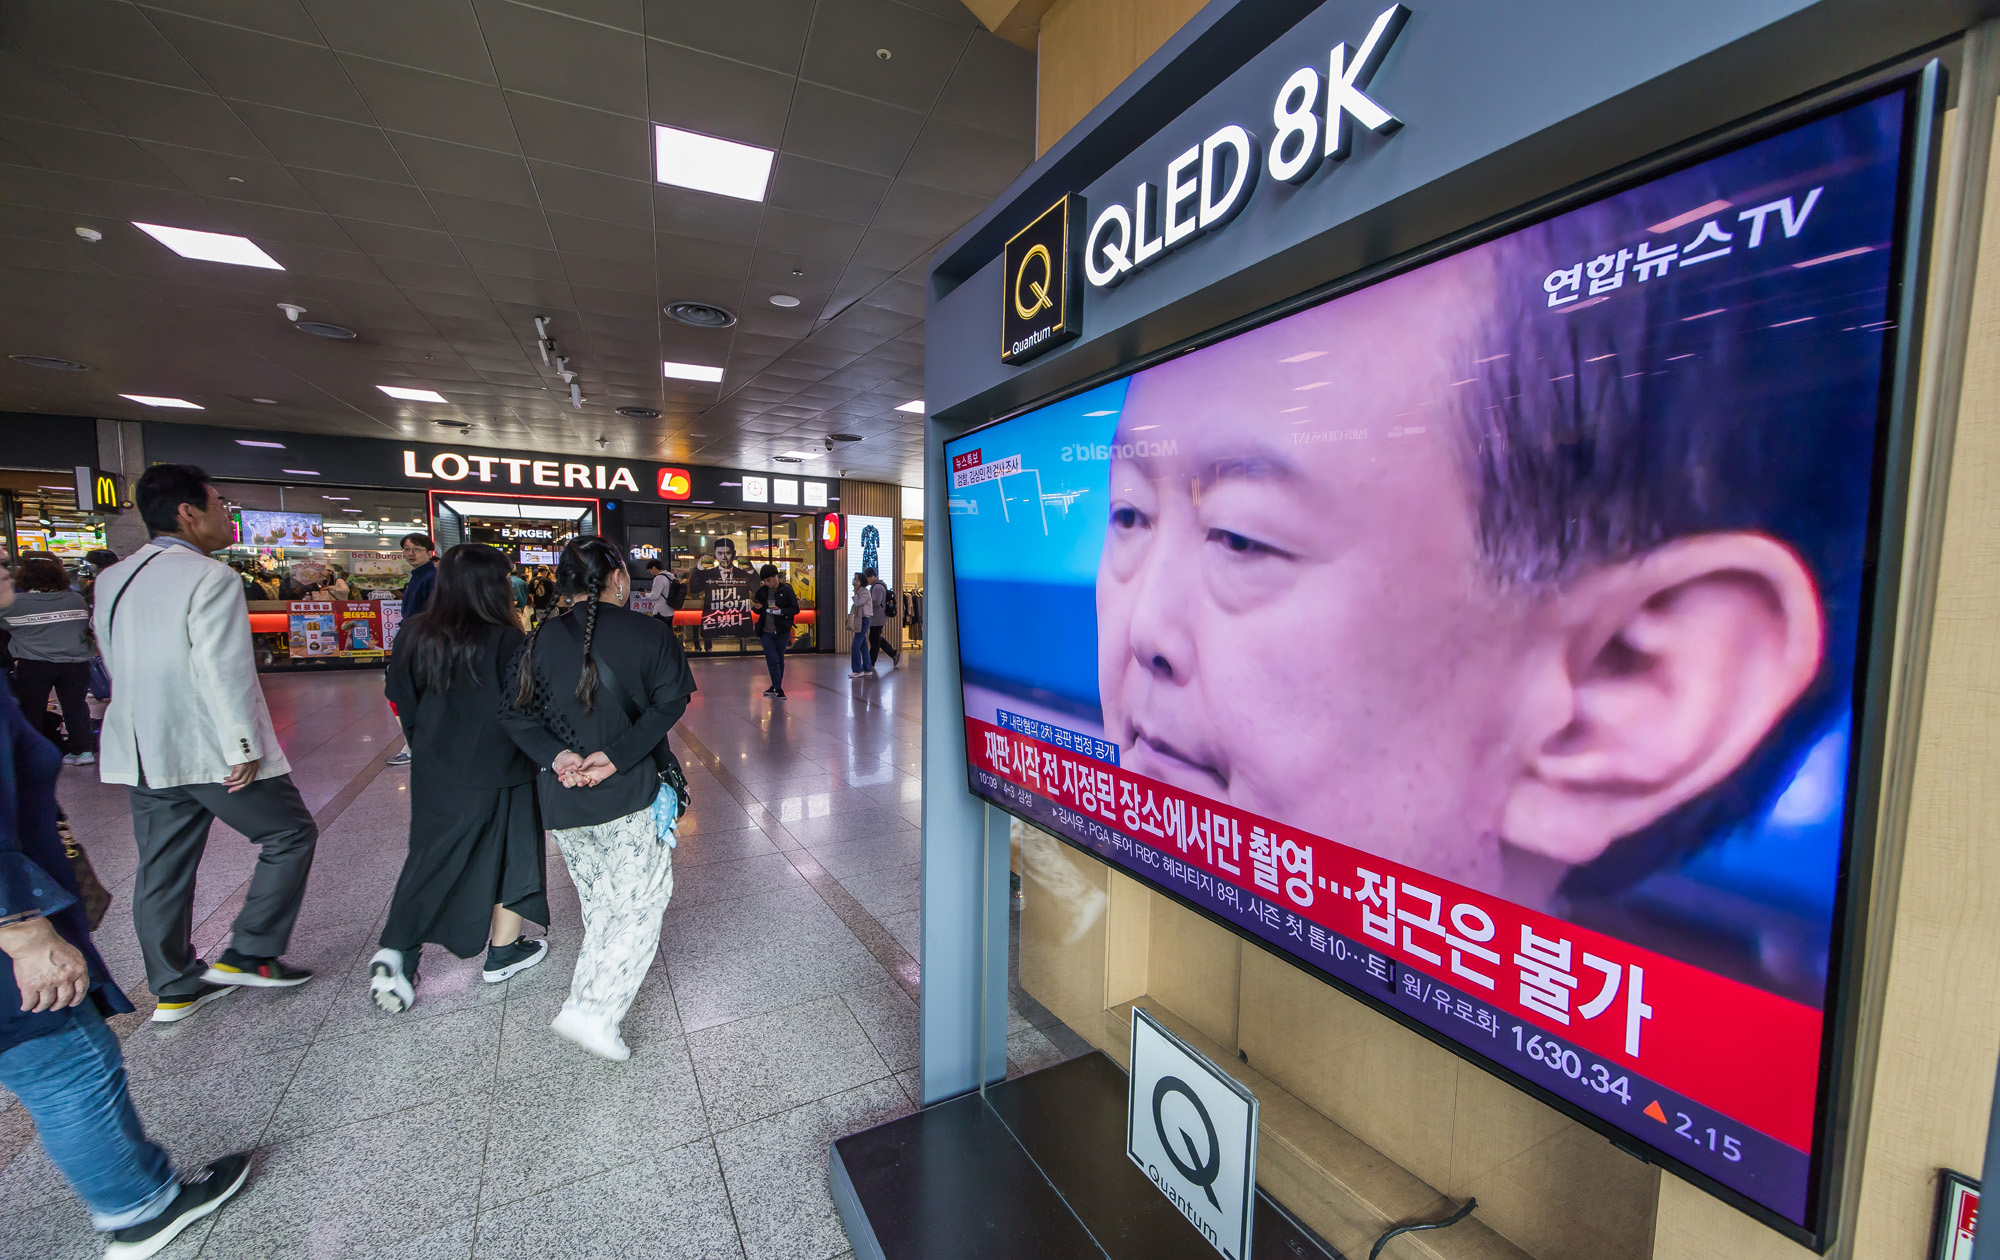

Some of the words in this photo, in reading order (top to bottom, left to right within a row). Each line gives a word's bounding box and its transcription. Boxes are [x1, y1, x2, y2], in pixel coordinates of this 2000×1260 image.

[1085, 124, 1250, 286] QLED
[1268, 3, 1399, 181] 8K
[1012, 325, 1051, 355] Quantum
[403, 451, 639, 492] LOTTERIA
[956, 452, 979, 469] 뉴스특보
[957, 472, 969, 487] 검찰,
[986, 465, 992, 479] 전
[993, 462, 1005, 478] 검사
[1005, 458, 1019, 474] 조사
[634, 548, 658, 559] BUN
[704, 599, 751, 616] 맛있게
[711, 587, 740, 601] 버거,
[343, 611, 376, 619] 롯데잇츠
[1040, 725, 1053, 742] 2차
[1054, 729, 1072, 749] 공판
[1073, 734, 1092, 756] 법정
[1094, 742, 1115, 763] 공개
[979, 772, 997, 790] 10:09
[1003, 783, 1015, 799] 4-3
[1017, 789, 1033, 808] 삼성
[1059, 808, 1088, 836] 김시우,
[1088, 822, 1110, 844] PGA
[1112, 835, 1133, 857] 투어
[1135, 844, 1160, 868] RBC
[1162, 856, 1214, 897] 헤리티지
[1217, 882, 1243, 914] 8위,
[1248, 898, 1280, 930] 시즌
[1285, 913, 1303, 941] 첫
[985, 731, 1010, 774] 재판
[1012, 742, 1041, 788] 시작
[1042, 752, 1060, 795] 전
[1062, 761, 1117, 821] 지정된
[1120, 780, 1242, 876] 장소에서만
[1513, 924, 1653, 1058] 불가
[1402, 972, 1500, 1038] 원/유로화
[1512, 1025, 1631, 1105] 1630.34
[1674, 1112, 1742, 1163] 2.15
[1148, 1164, 1217, 1246] Quantum
